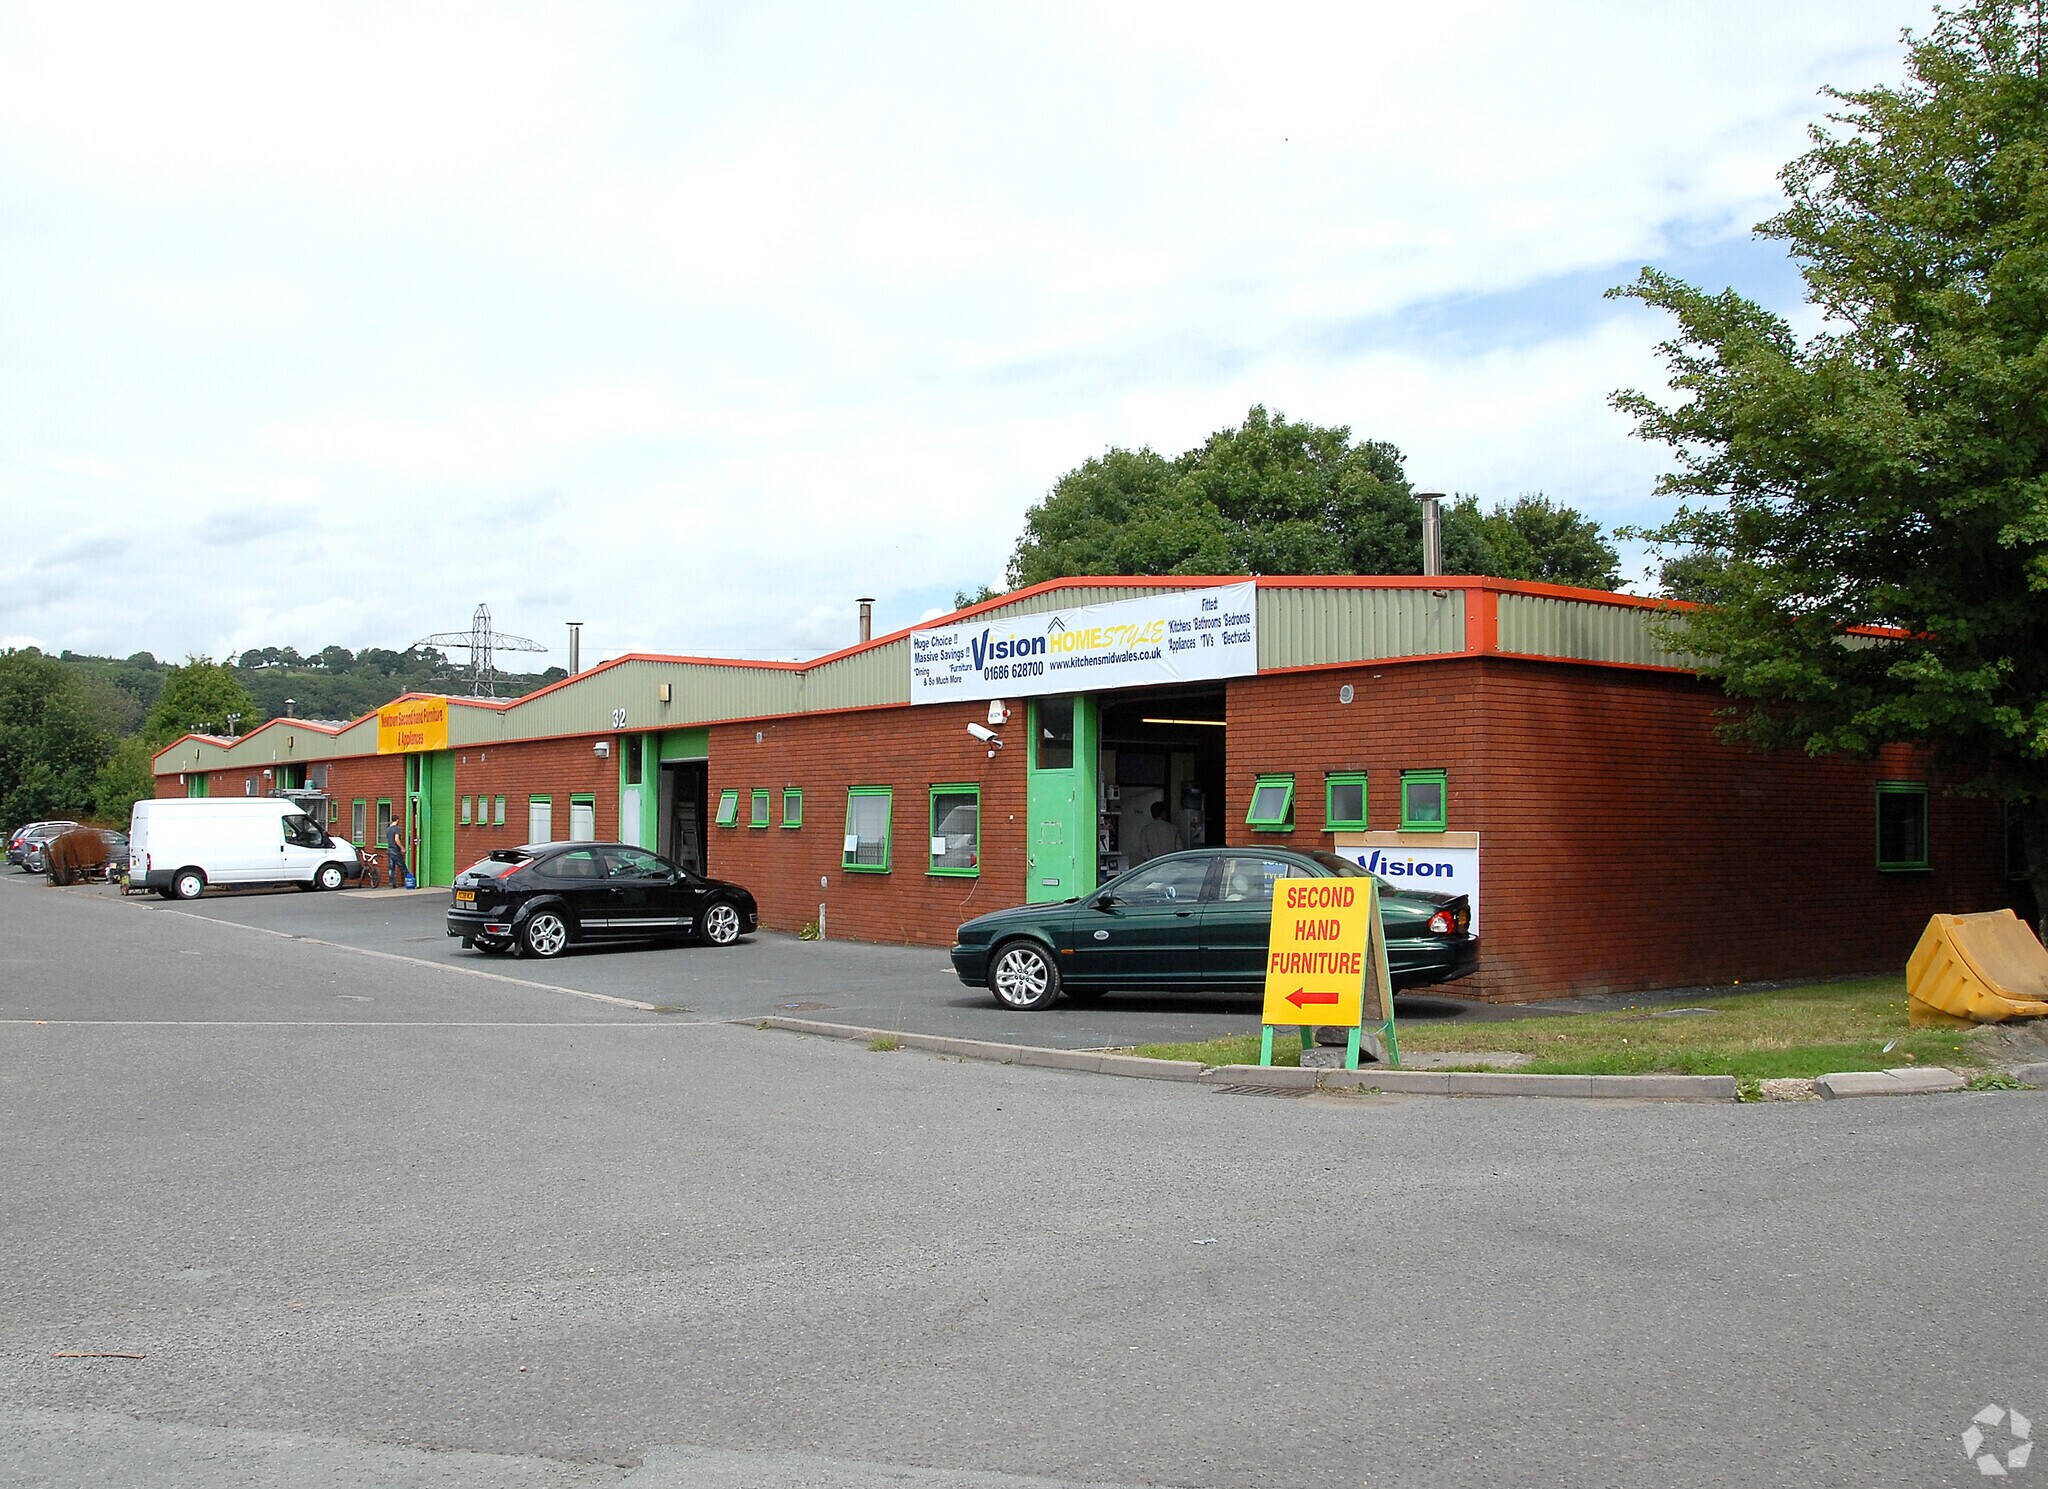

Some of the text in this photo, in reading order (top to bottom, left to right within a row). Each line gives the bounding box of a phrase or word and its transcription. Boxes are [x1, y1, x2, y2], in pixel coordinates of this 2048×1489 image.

[914, 638, 929, 651] Huge
[931, 634, 952, 647] Choice
[971, 628, 1046, 671] Vision
[914, 652, 938, 663] Massive
[940, 648, 964, 661] Savings
[1050, 647, 1161, 670] www.kitchensmidwales.co.uk
[929, 677, 935, 685] So
[936, 676, 948, 684] Much
[950, 675, 962, 683] More
[984, 661, 1044, 681] 01686 628700
[613, 708, 626, 728] 32
[1357, 849, 1453, 877] Vision
[1287, 886, 1355, 909] SECOND
[1294, 919, 1341, 941] HAND
[1270, 952, 1361, 975] FURNITURE
